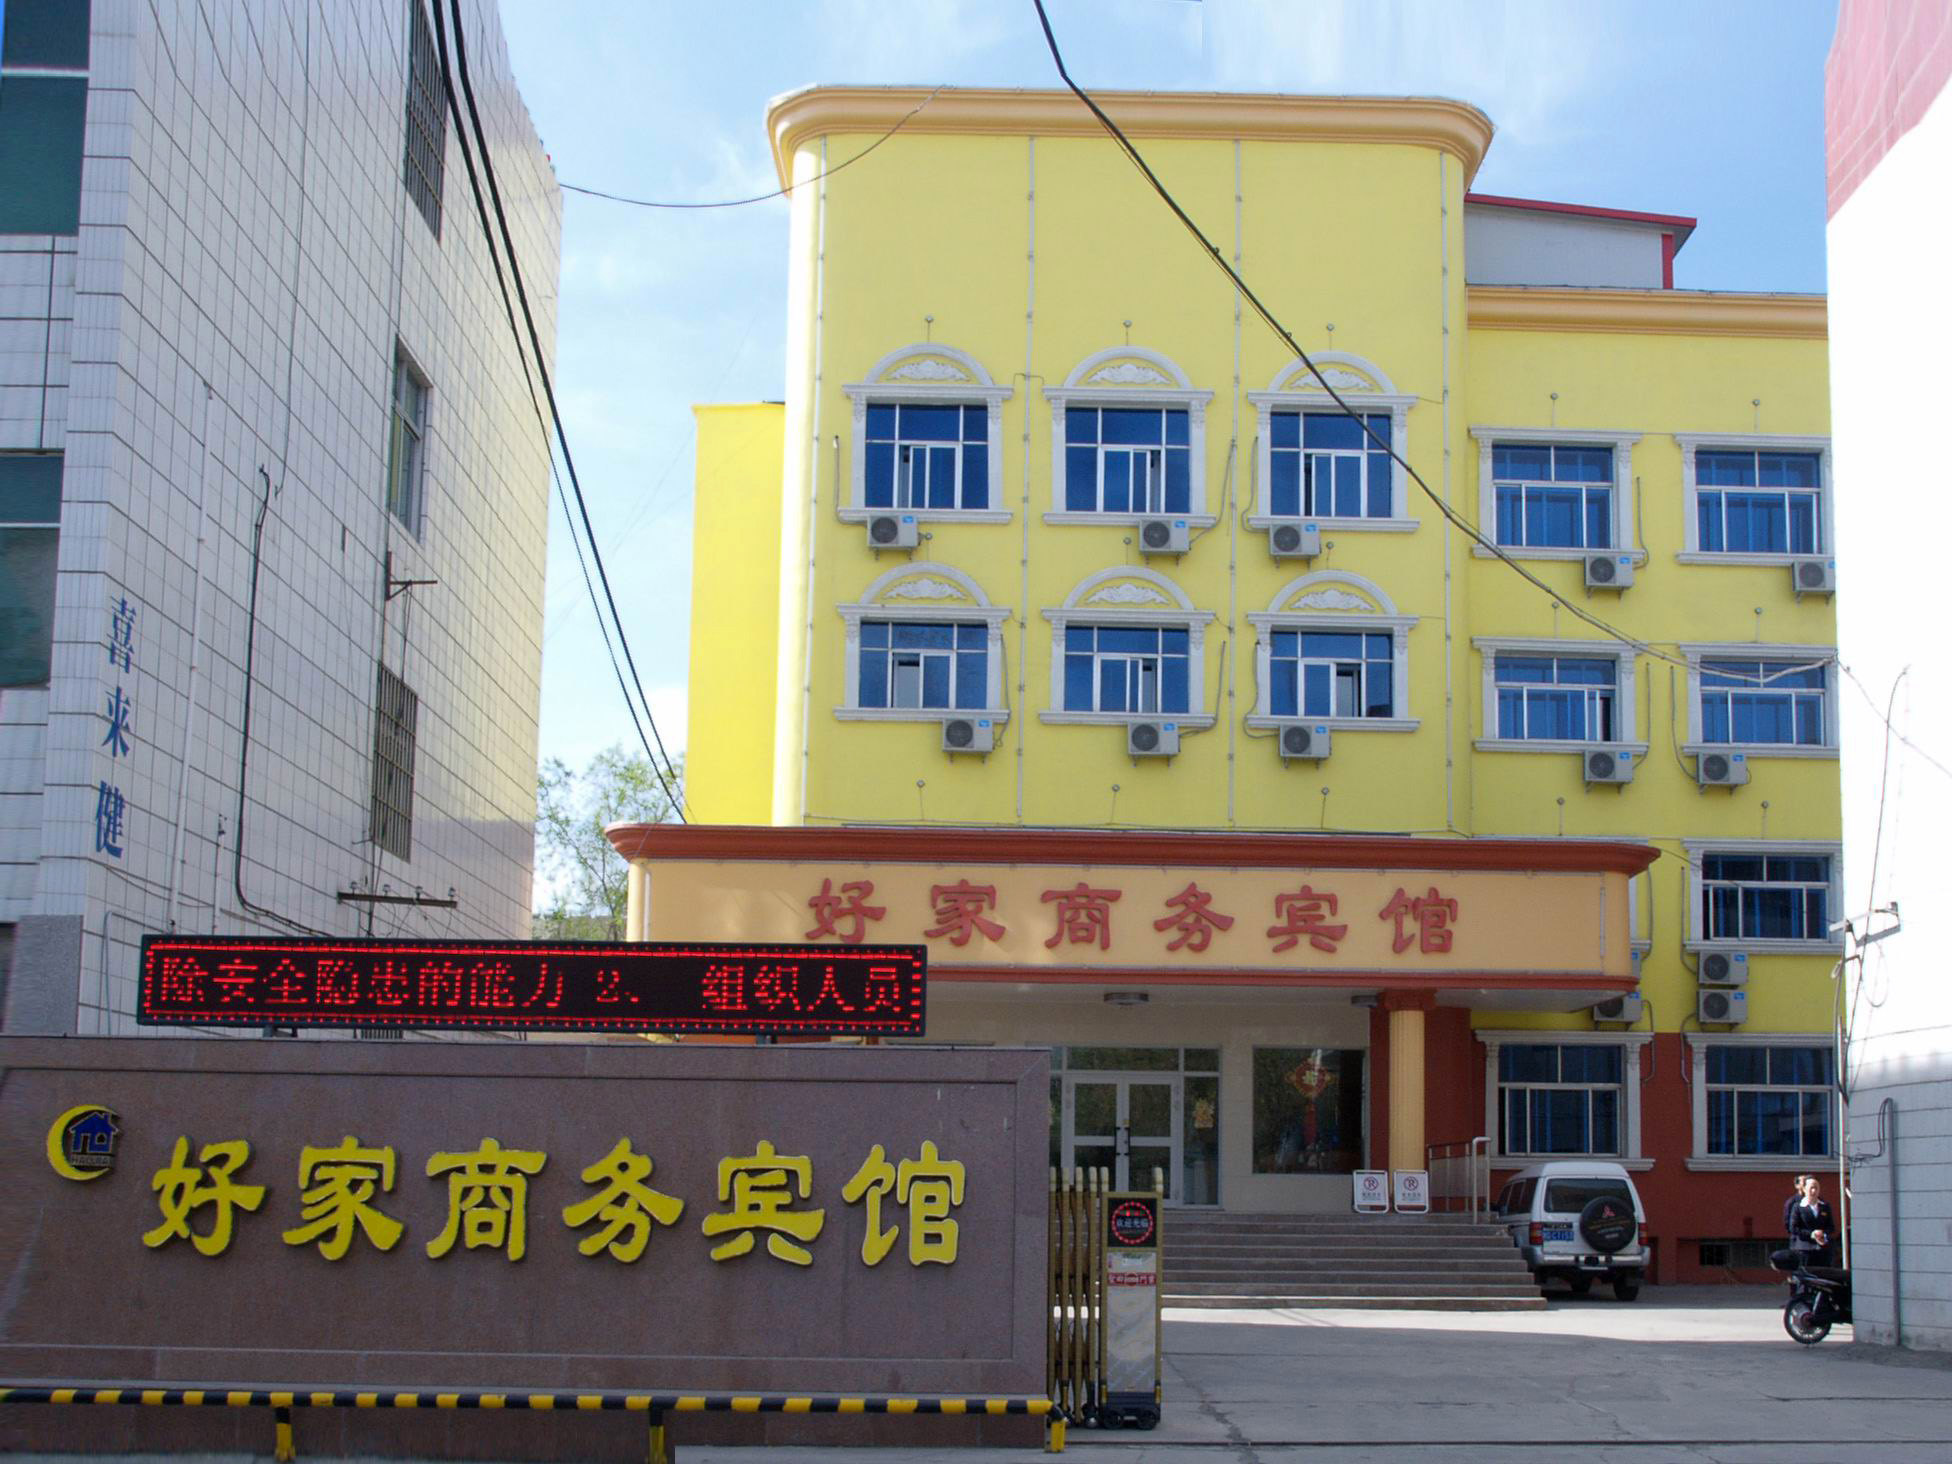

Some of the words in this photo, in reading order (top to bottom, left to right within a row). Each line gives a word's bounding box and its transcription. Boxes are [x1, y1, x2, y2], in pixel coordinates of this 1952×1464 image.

[95, 598, 136, 859] 喜来健
[805, 878, 1459, 954] 好家商务宾馆
[701, 964, 903, 1013] 组织人员
[143, 1135, 967, 1266] 好家商务宾馆
